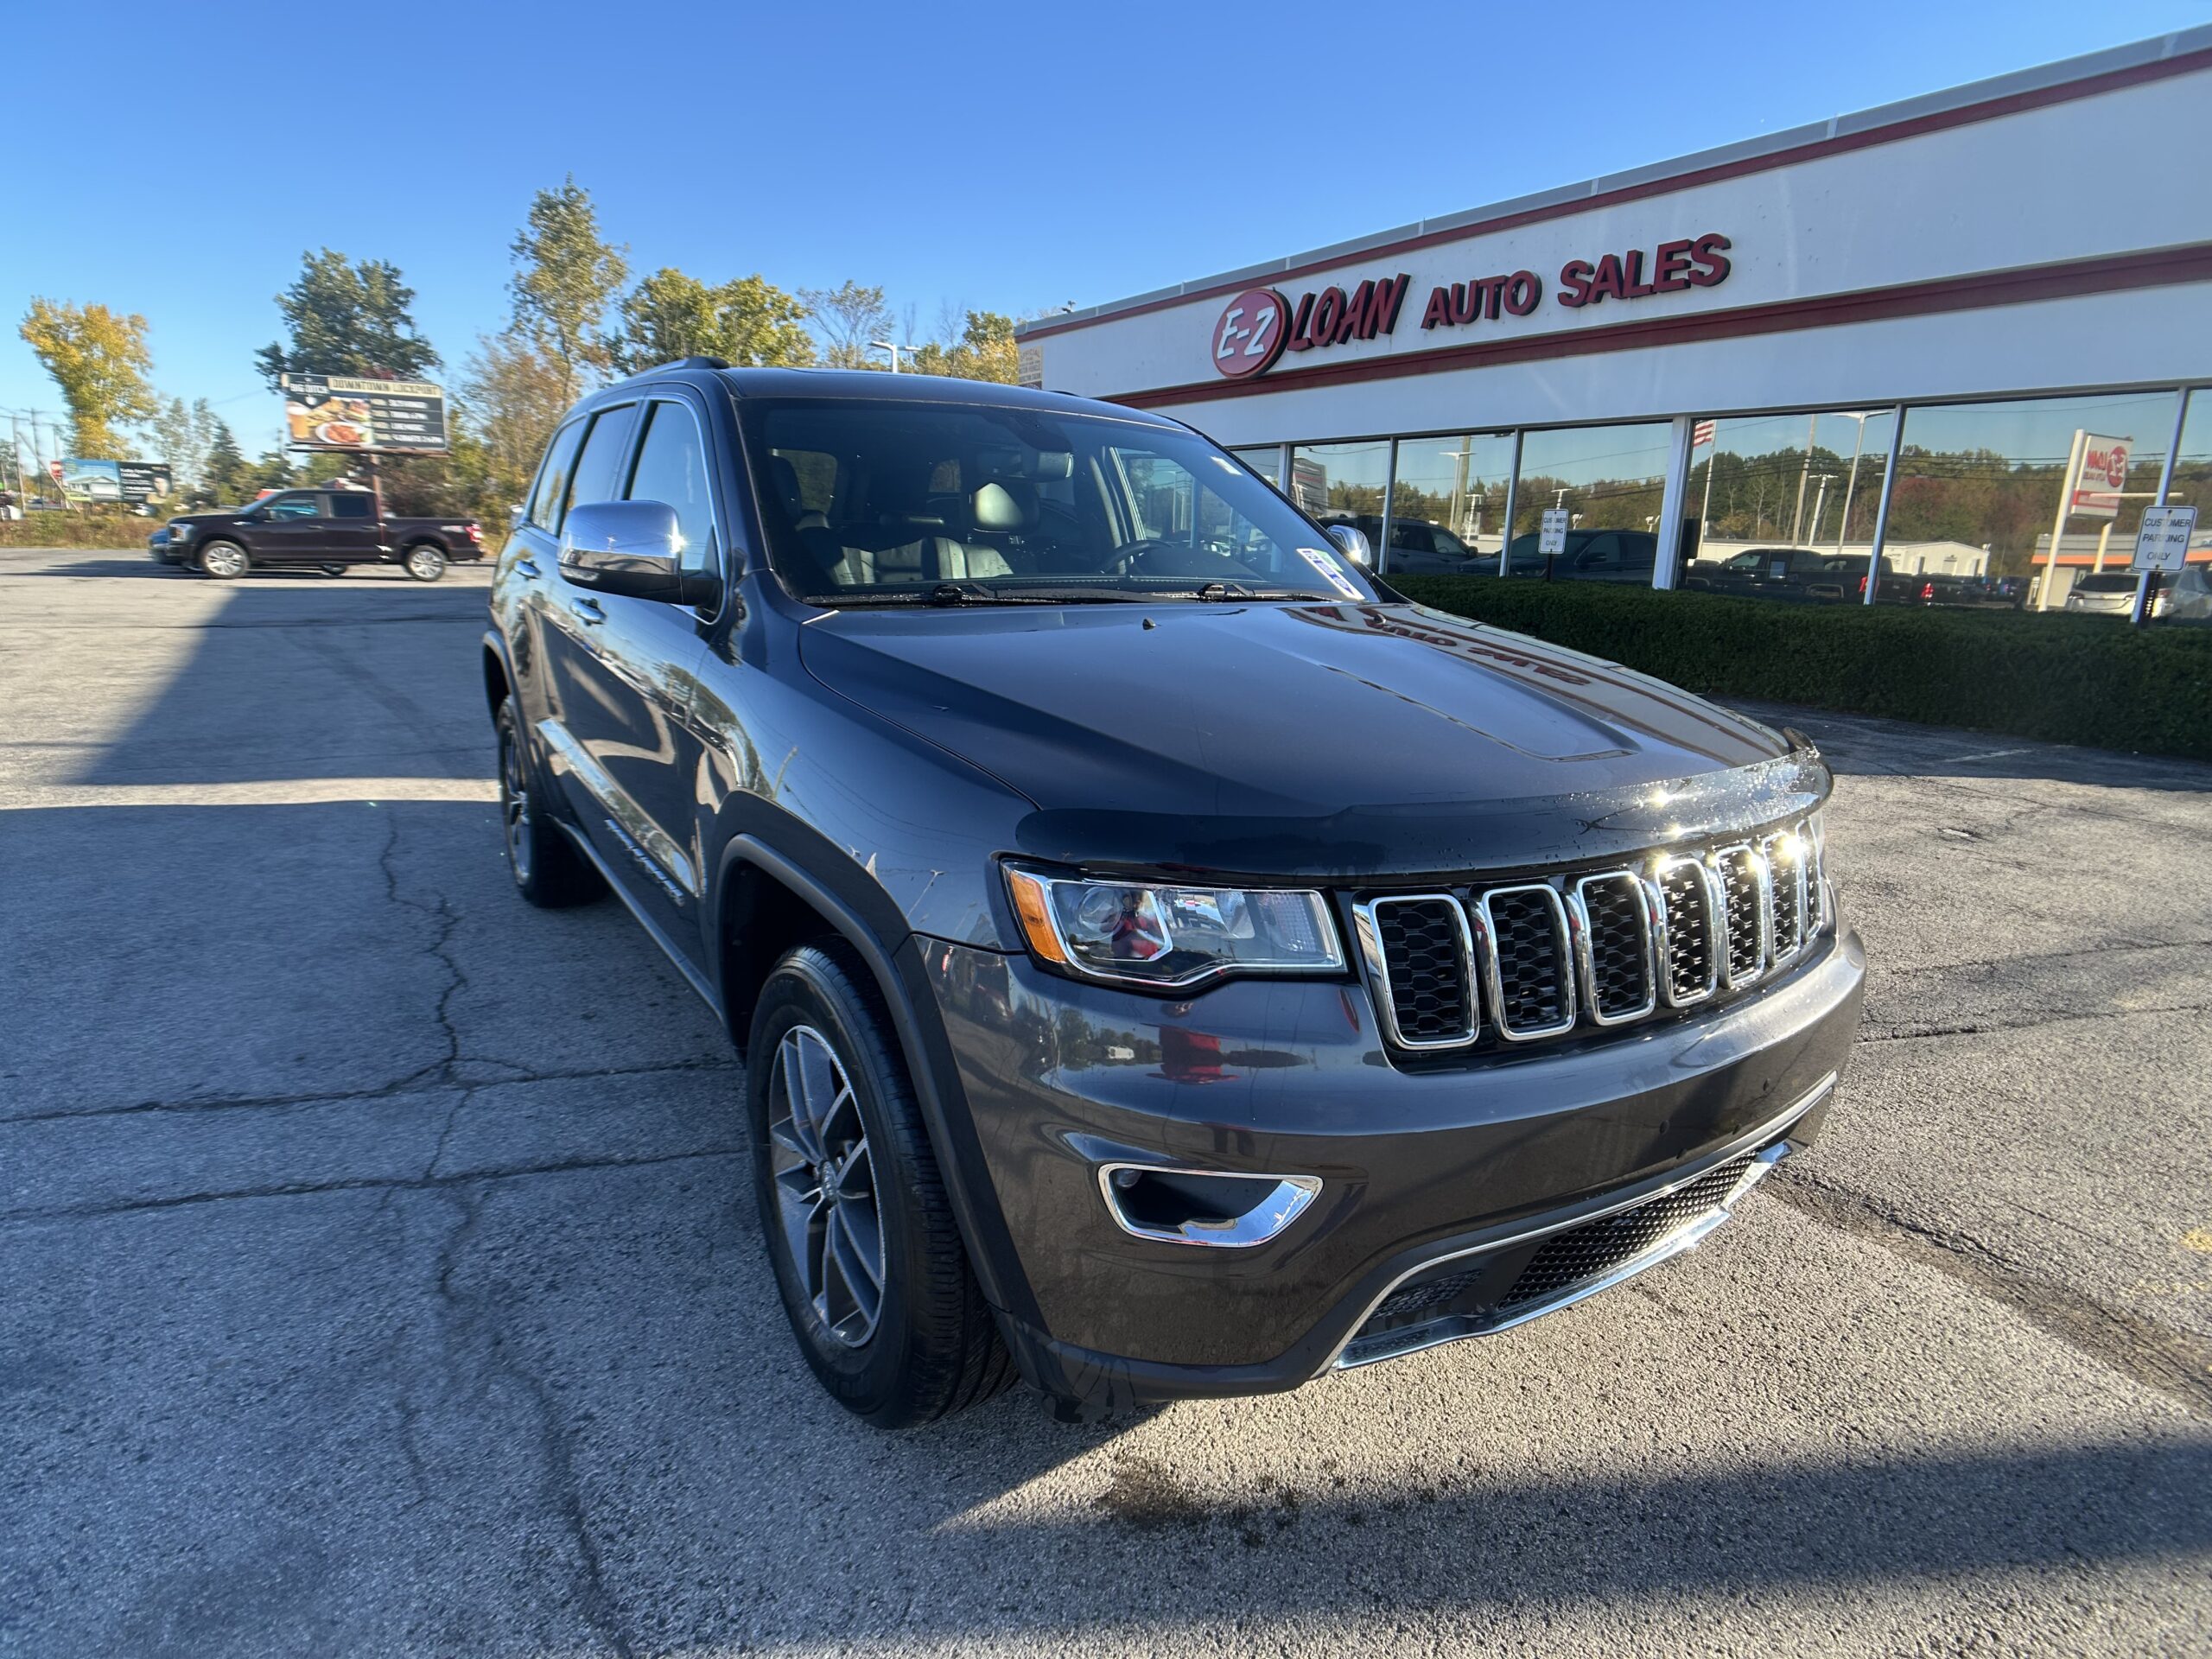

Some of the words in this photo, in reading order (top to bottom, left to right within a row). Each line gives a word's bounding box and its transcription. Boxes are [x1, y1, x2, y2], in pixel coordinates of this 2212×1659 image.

[1217, 306, 1276, 360] E-Z
[1288, 274, 1411, 351] LOAN
[1421, 270, 1541, 330] AUTO
[1558, 232, 1732, 308] SALES
[332, 378, 389, 391] DOWNTOWN
[393, 383, 438, 395] LOCKPORT
[2145, 518, 2191, 527] CUSOMER
[2143, 533, 2184, 543] PARING
[2146, 551, 2171, 561] ONLY
